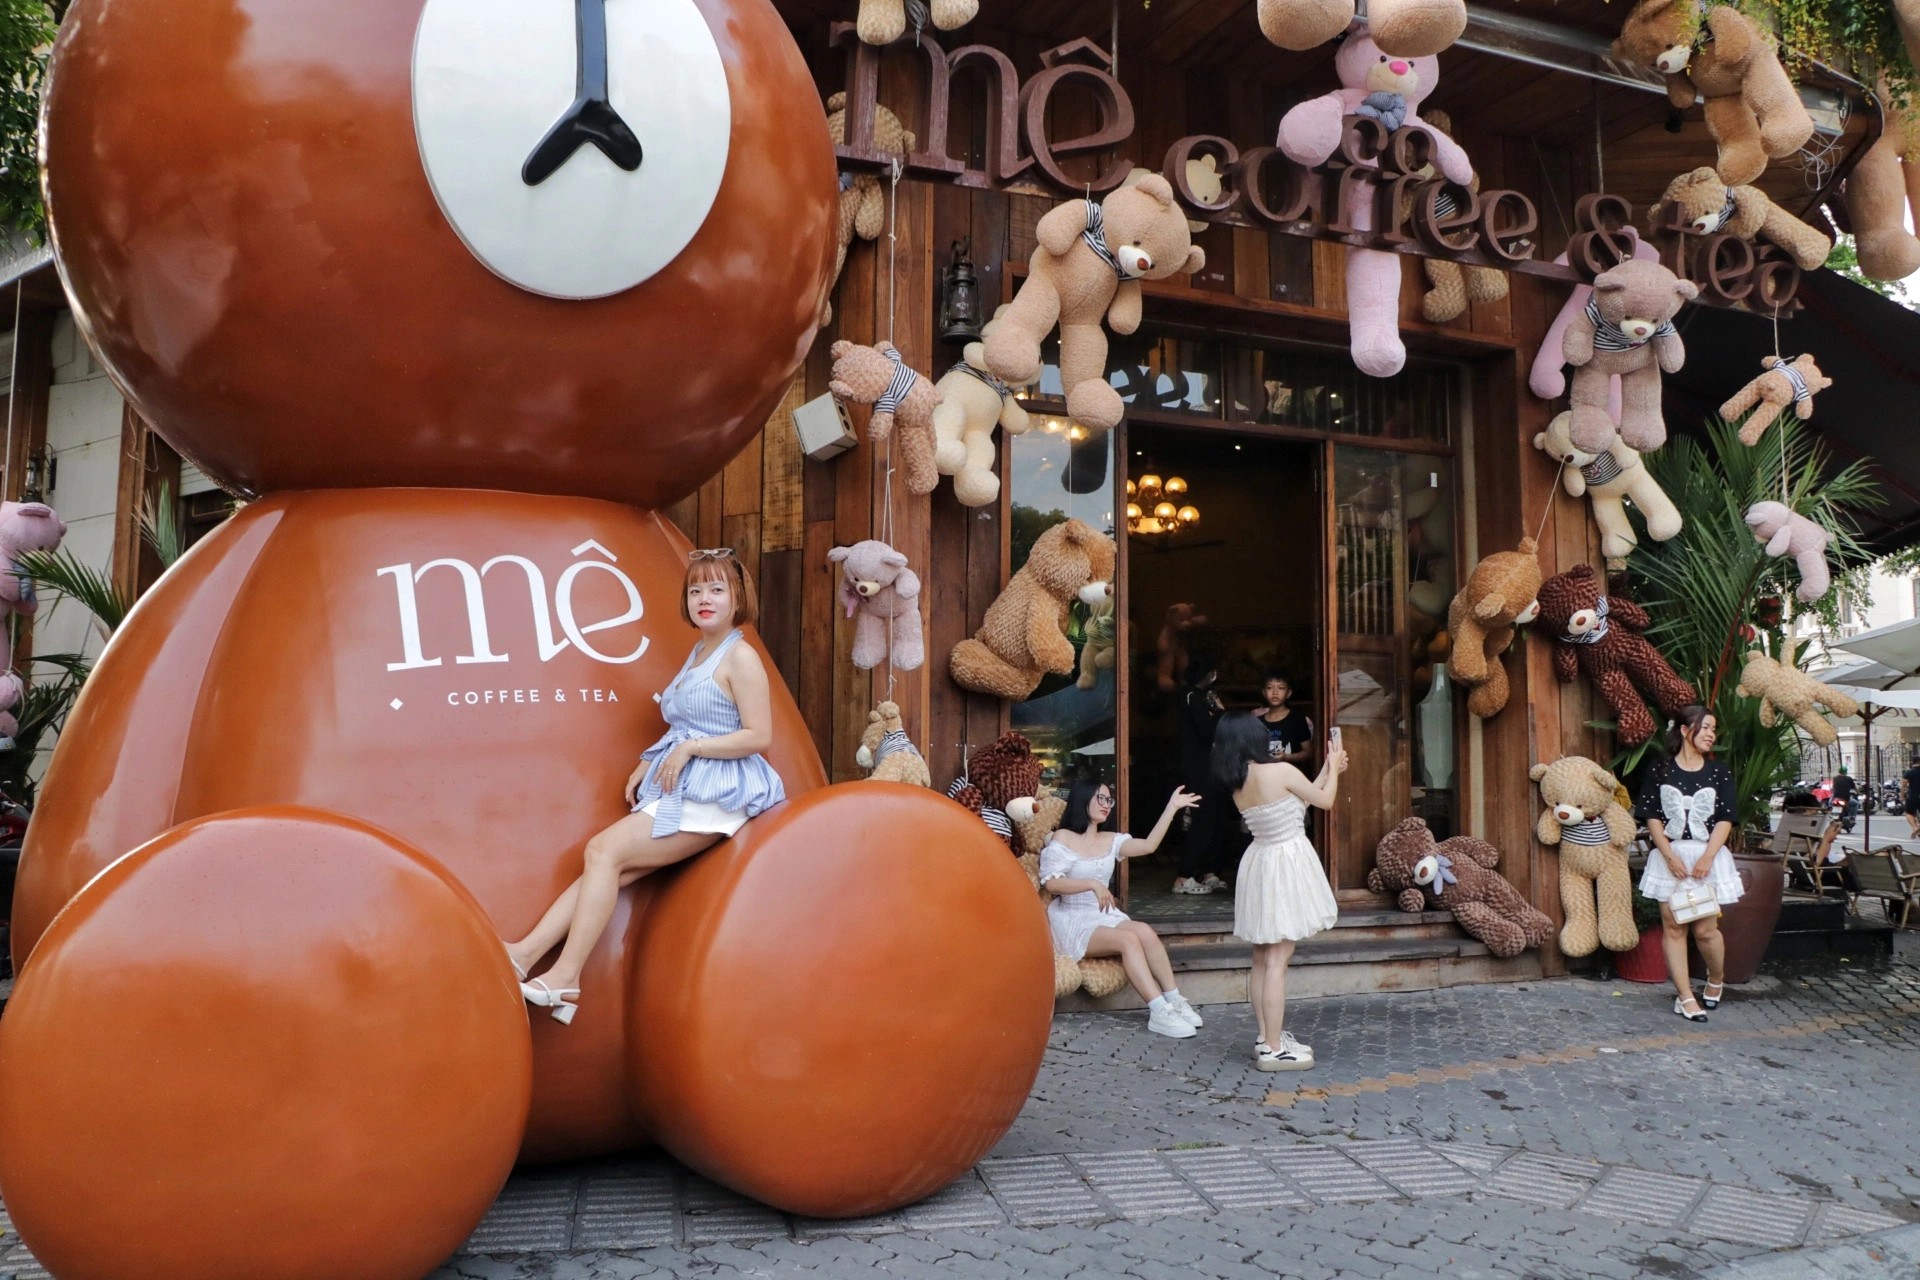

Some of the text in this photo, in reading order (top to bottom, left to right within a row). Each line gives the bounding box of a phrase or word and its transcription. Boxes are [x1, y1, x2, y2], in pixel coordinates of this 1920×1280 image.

[829, 20, 1805, 312] mê coffee & tea
[376, 538, 651, 672] mê
[447, 688, 619, 706] COFFEE & TEA
